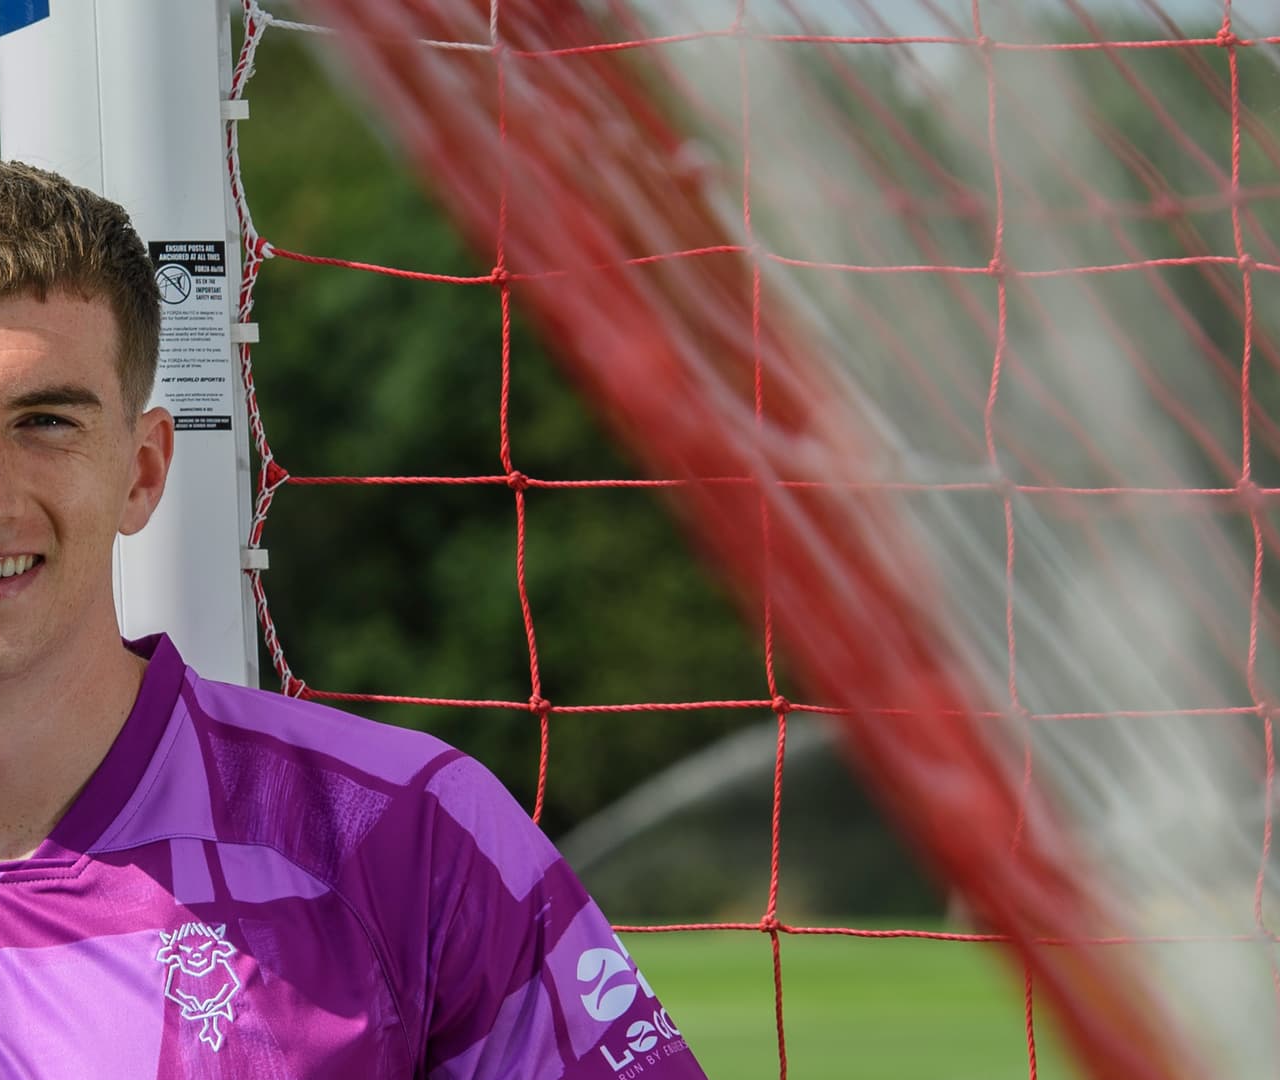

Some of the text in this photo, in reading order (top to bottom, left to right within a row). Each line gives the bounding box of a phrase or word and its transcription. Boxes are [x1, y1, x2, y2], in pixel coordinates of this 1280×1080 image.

[165, 244, 187, 252] ENSURE
[188, 244, 204, 252] POSTS
[646, 1050, 661, 1065] BY
